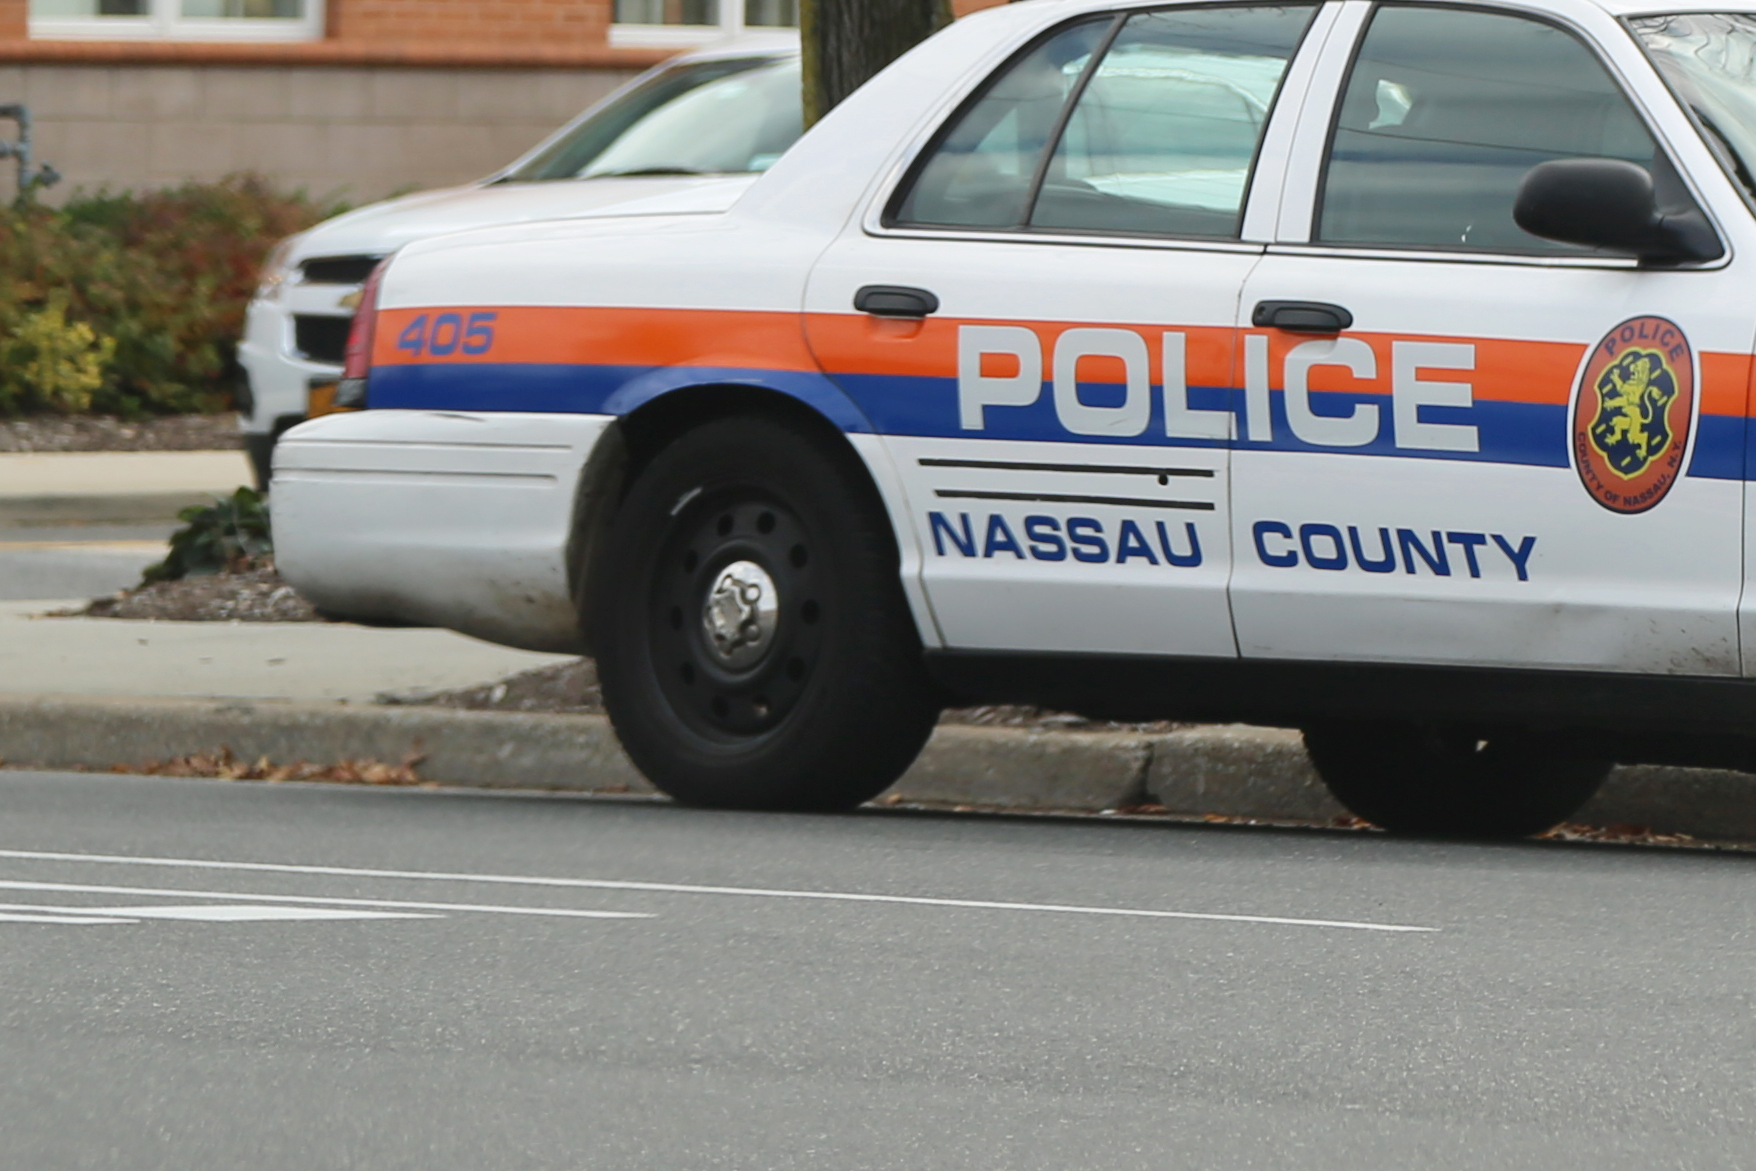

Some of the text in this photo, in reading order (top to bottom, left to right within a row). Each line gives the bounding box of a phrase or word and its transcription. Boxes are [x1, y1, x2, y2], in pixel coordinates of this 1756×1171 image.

[396, 312, 497, 357] 405
[1604, 322, 1684, 362] POLICE
[957, 325, 1480, 452] POLICE
[1577, 432, 1605, 491] COUNTY
[1604, 490, 1620, 504] OF
[928, 511, 1537, 582] NASSAU COUNTY
